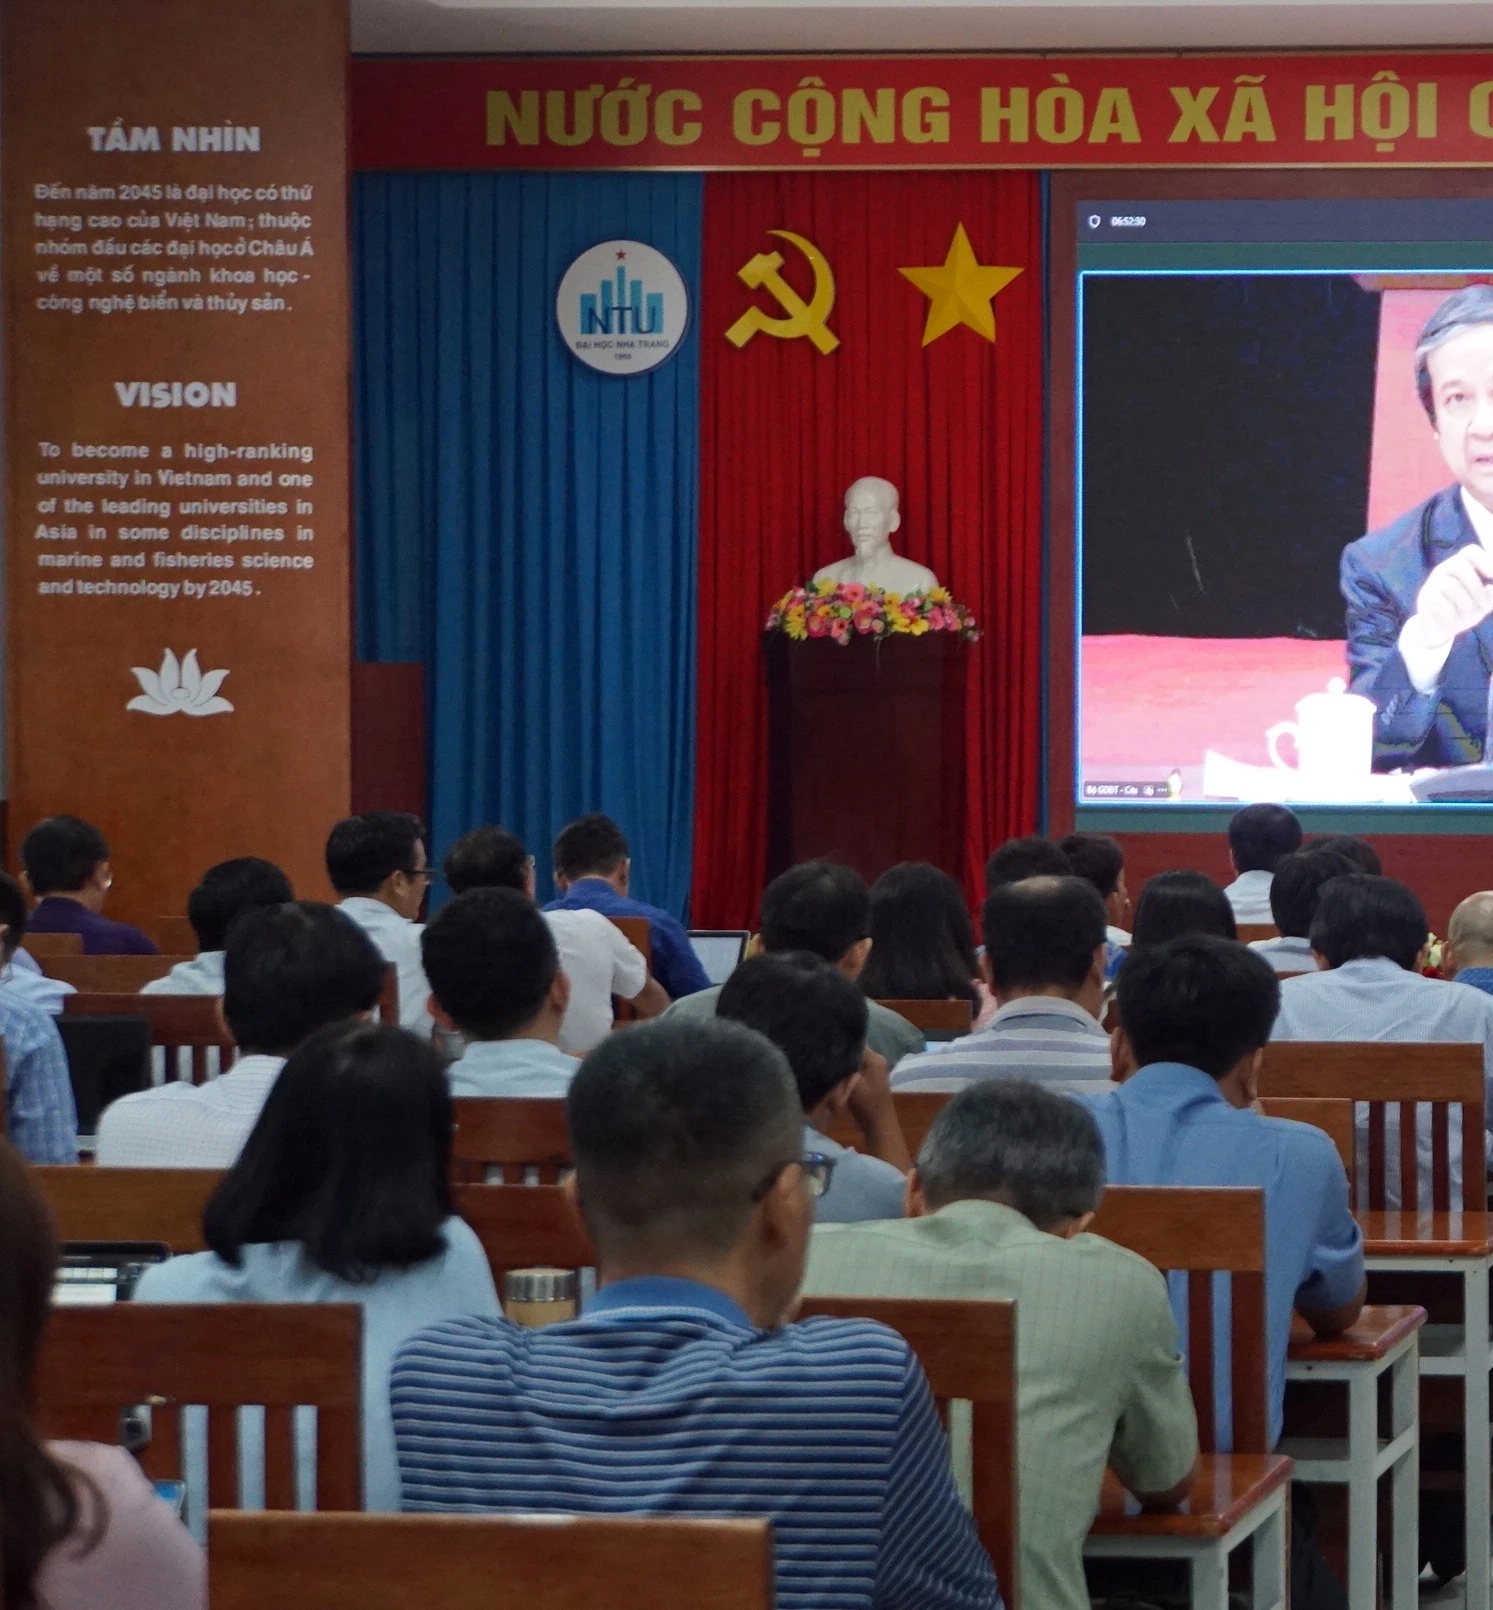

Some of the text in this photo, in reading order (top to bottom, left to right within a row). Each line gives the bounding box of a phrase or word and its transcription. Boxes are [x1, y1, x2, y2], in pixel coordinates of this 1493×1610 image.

[486, 77, 703, 146] NƯỚC
[733, 77, 952, 157] CỘNG
[981, 73, 1142, 143] HÒA
[1168, 75, 1277, 143] XÃ
[1305, 71, 1437, 152] HỘI
[88, 116, 261, 152] TẦM NHÌN
[34, 183, 313, 203] Đến năm 2045 là đại học có thứ
[35, 213, 83, 232] hạng
[88, 215, 123, 228] cao
[126, 210, 161, 228] của
[164, 213, 200, 232] Việt
[258, 213, 312, 232] thuộc
[130, 240, 162, 255] các
[167, 241, 195, 259] đại
[249, 241, 298, 256] Châu
[299, 237, 314, 255] Á
[37, 265, 59, 282] về
[67, 269, 102, 286] một
[111, 265, 134, 282] số
[142, 268, 201, 286] ngành
[210, 268, 255, 283] khoa
[264, 268, 299, 287] học
[37, 295, 84, 313] công
[89, 296, 136, 314] nghệ
[139, 290, 179, 311] biển
[183, 295, 204, 311] và
[207, 294, 247, 315] thủy
[588, 306, 655, 334] NTU
[594, 340, 613, 350] HỌC
[616, 340, 634, 348] NHA
[638, 340, 669, 348] TRANG
[115, 382, 237, 408] VISION
[38, 442, 313, 462] To become a high-ranking
[37, 469, 313, 488] university in Vietnam and one
[38, 498, 312, 517] of the leading universities in
[36, 524, 313, 544] Asia in some disciplines in
[38, 552, 314, 568] marine and fisheries science
[38, 580, 74, 595] and
[77, 579, 180, 599] technology
[183, 579, 206, 598] by
